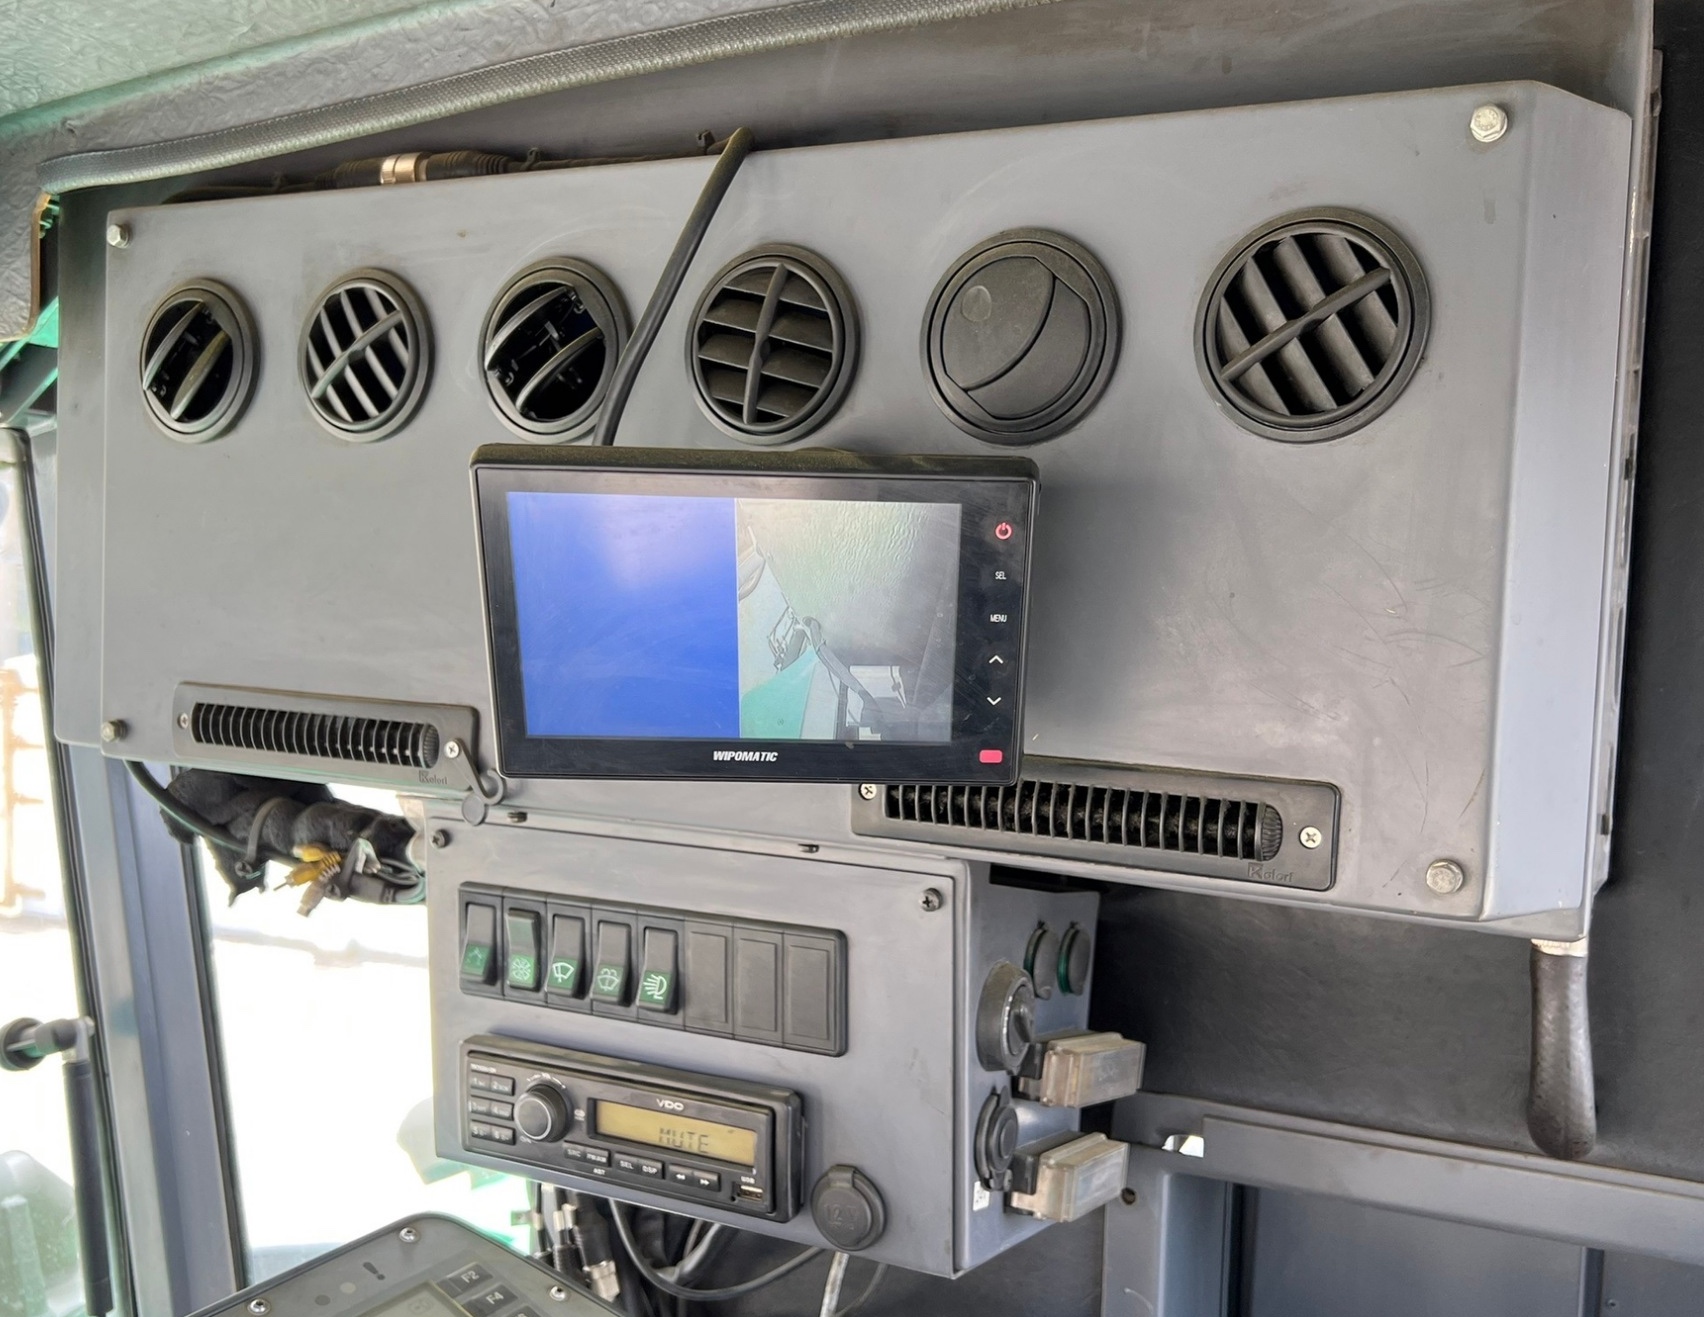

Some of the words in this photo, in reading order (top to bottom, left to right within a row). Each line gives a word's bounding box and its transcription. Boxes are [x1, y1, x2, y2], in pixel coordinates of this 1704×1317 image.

[995, 571, 1007, 580] SEL
[990, 614, 1008, 623] MENU
[713, 750, 778, 762] WIPOMATIC
[656, 1098, 684, 1111] VDO
[658, 1127, 709, 1154] MUTE
[620, 1160, 634, 1169] SEL
[642, 1165, 658, 1175] DSP
[461, 1270, 480, 1283] F2
[486, 1291, 504, 1305] F4
